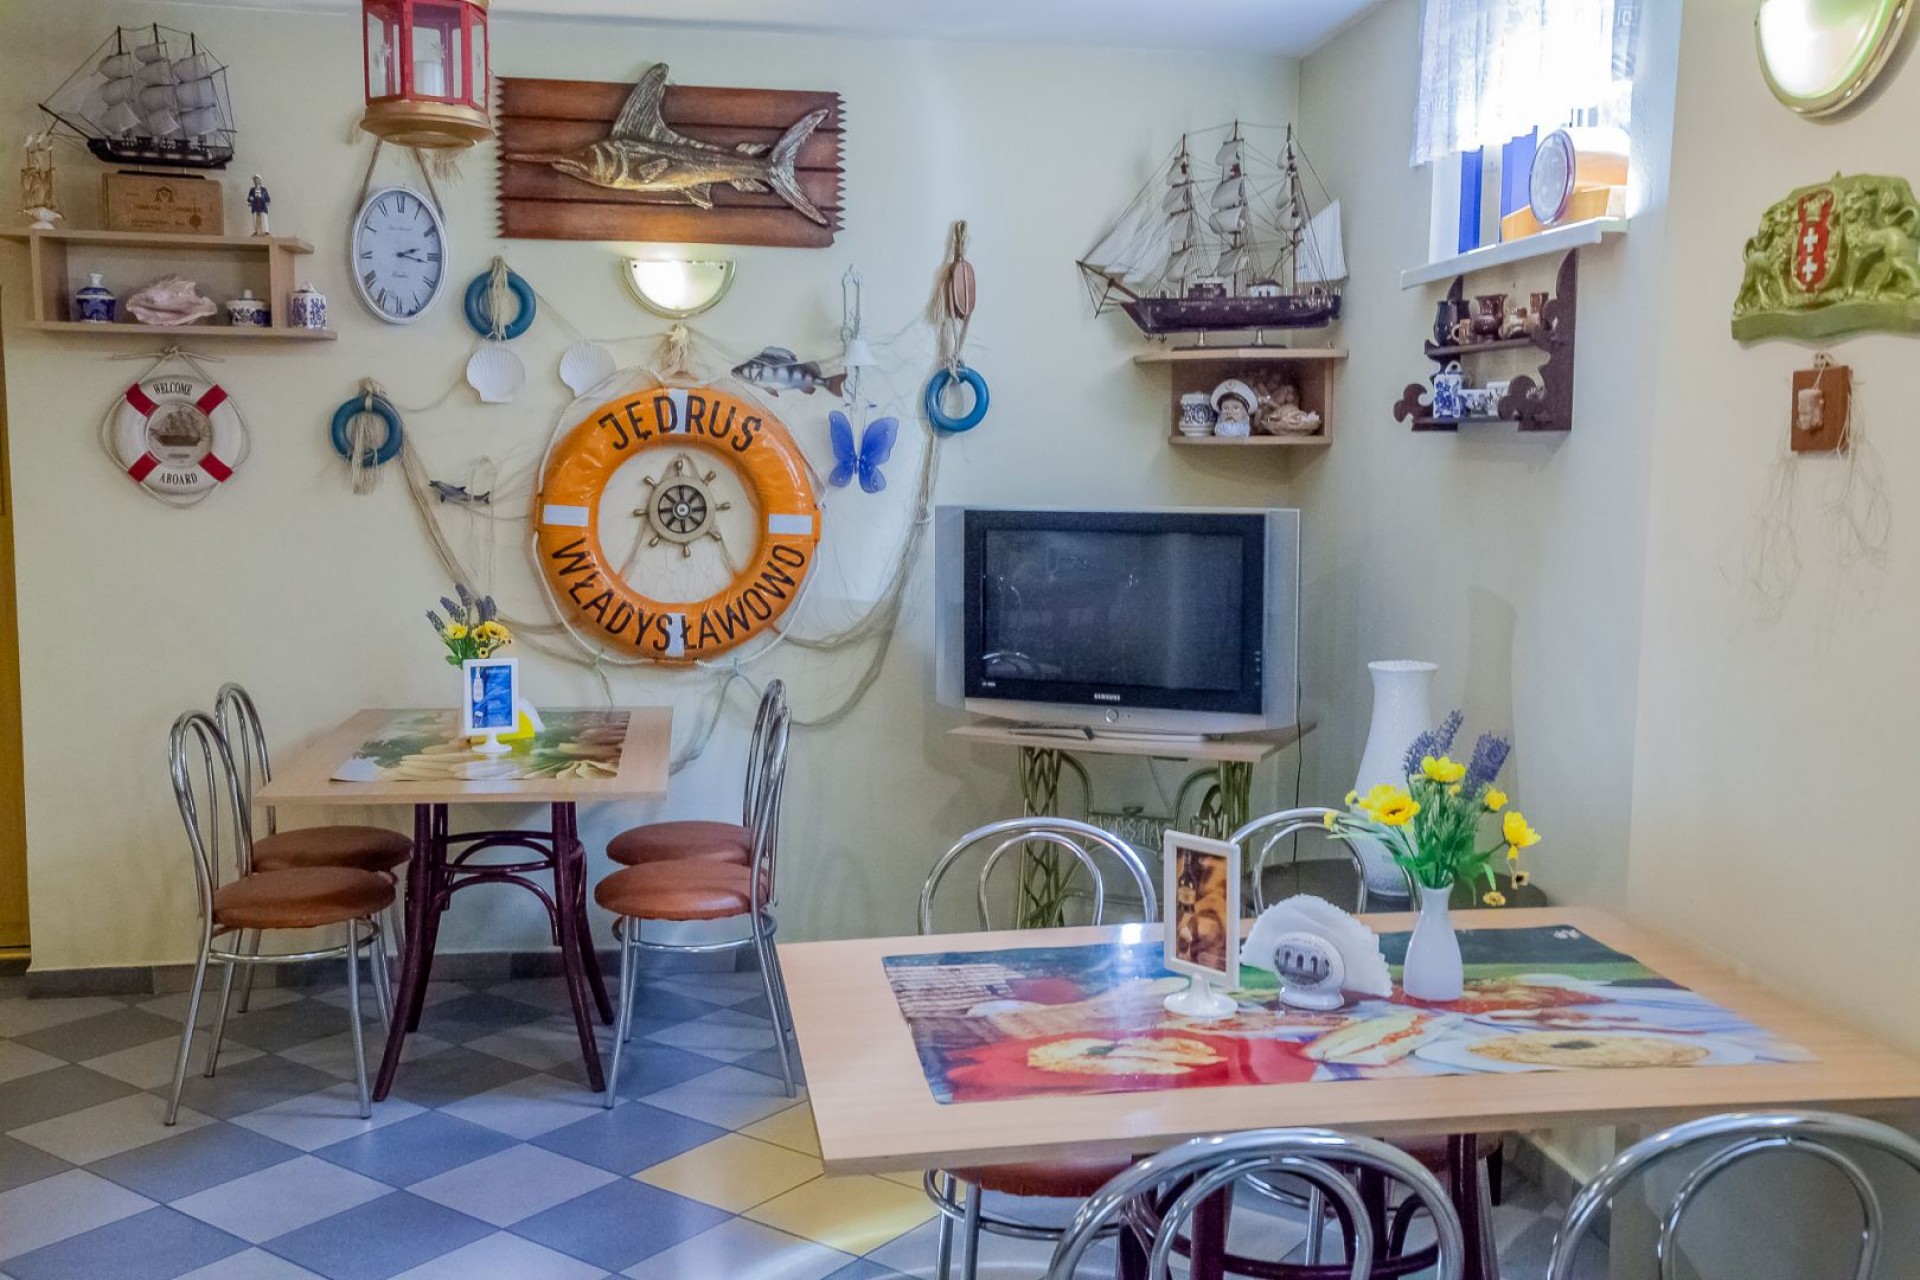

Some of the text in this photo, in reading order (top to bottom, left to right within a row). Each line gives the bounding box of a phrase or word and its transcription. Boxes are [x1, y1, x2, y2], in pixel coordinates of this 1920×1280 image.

[153, 382, 193, 396] WELCOME
[159, 472, 198, 485] ABOARD
[551, 537, 806, 651] WŁADYSŁAWOWO
